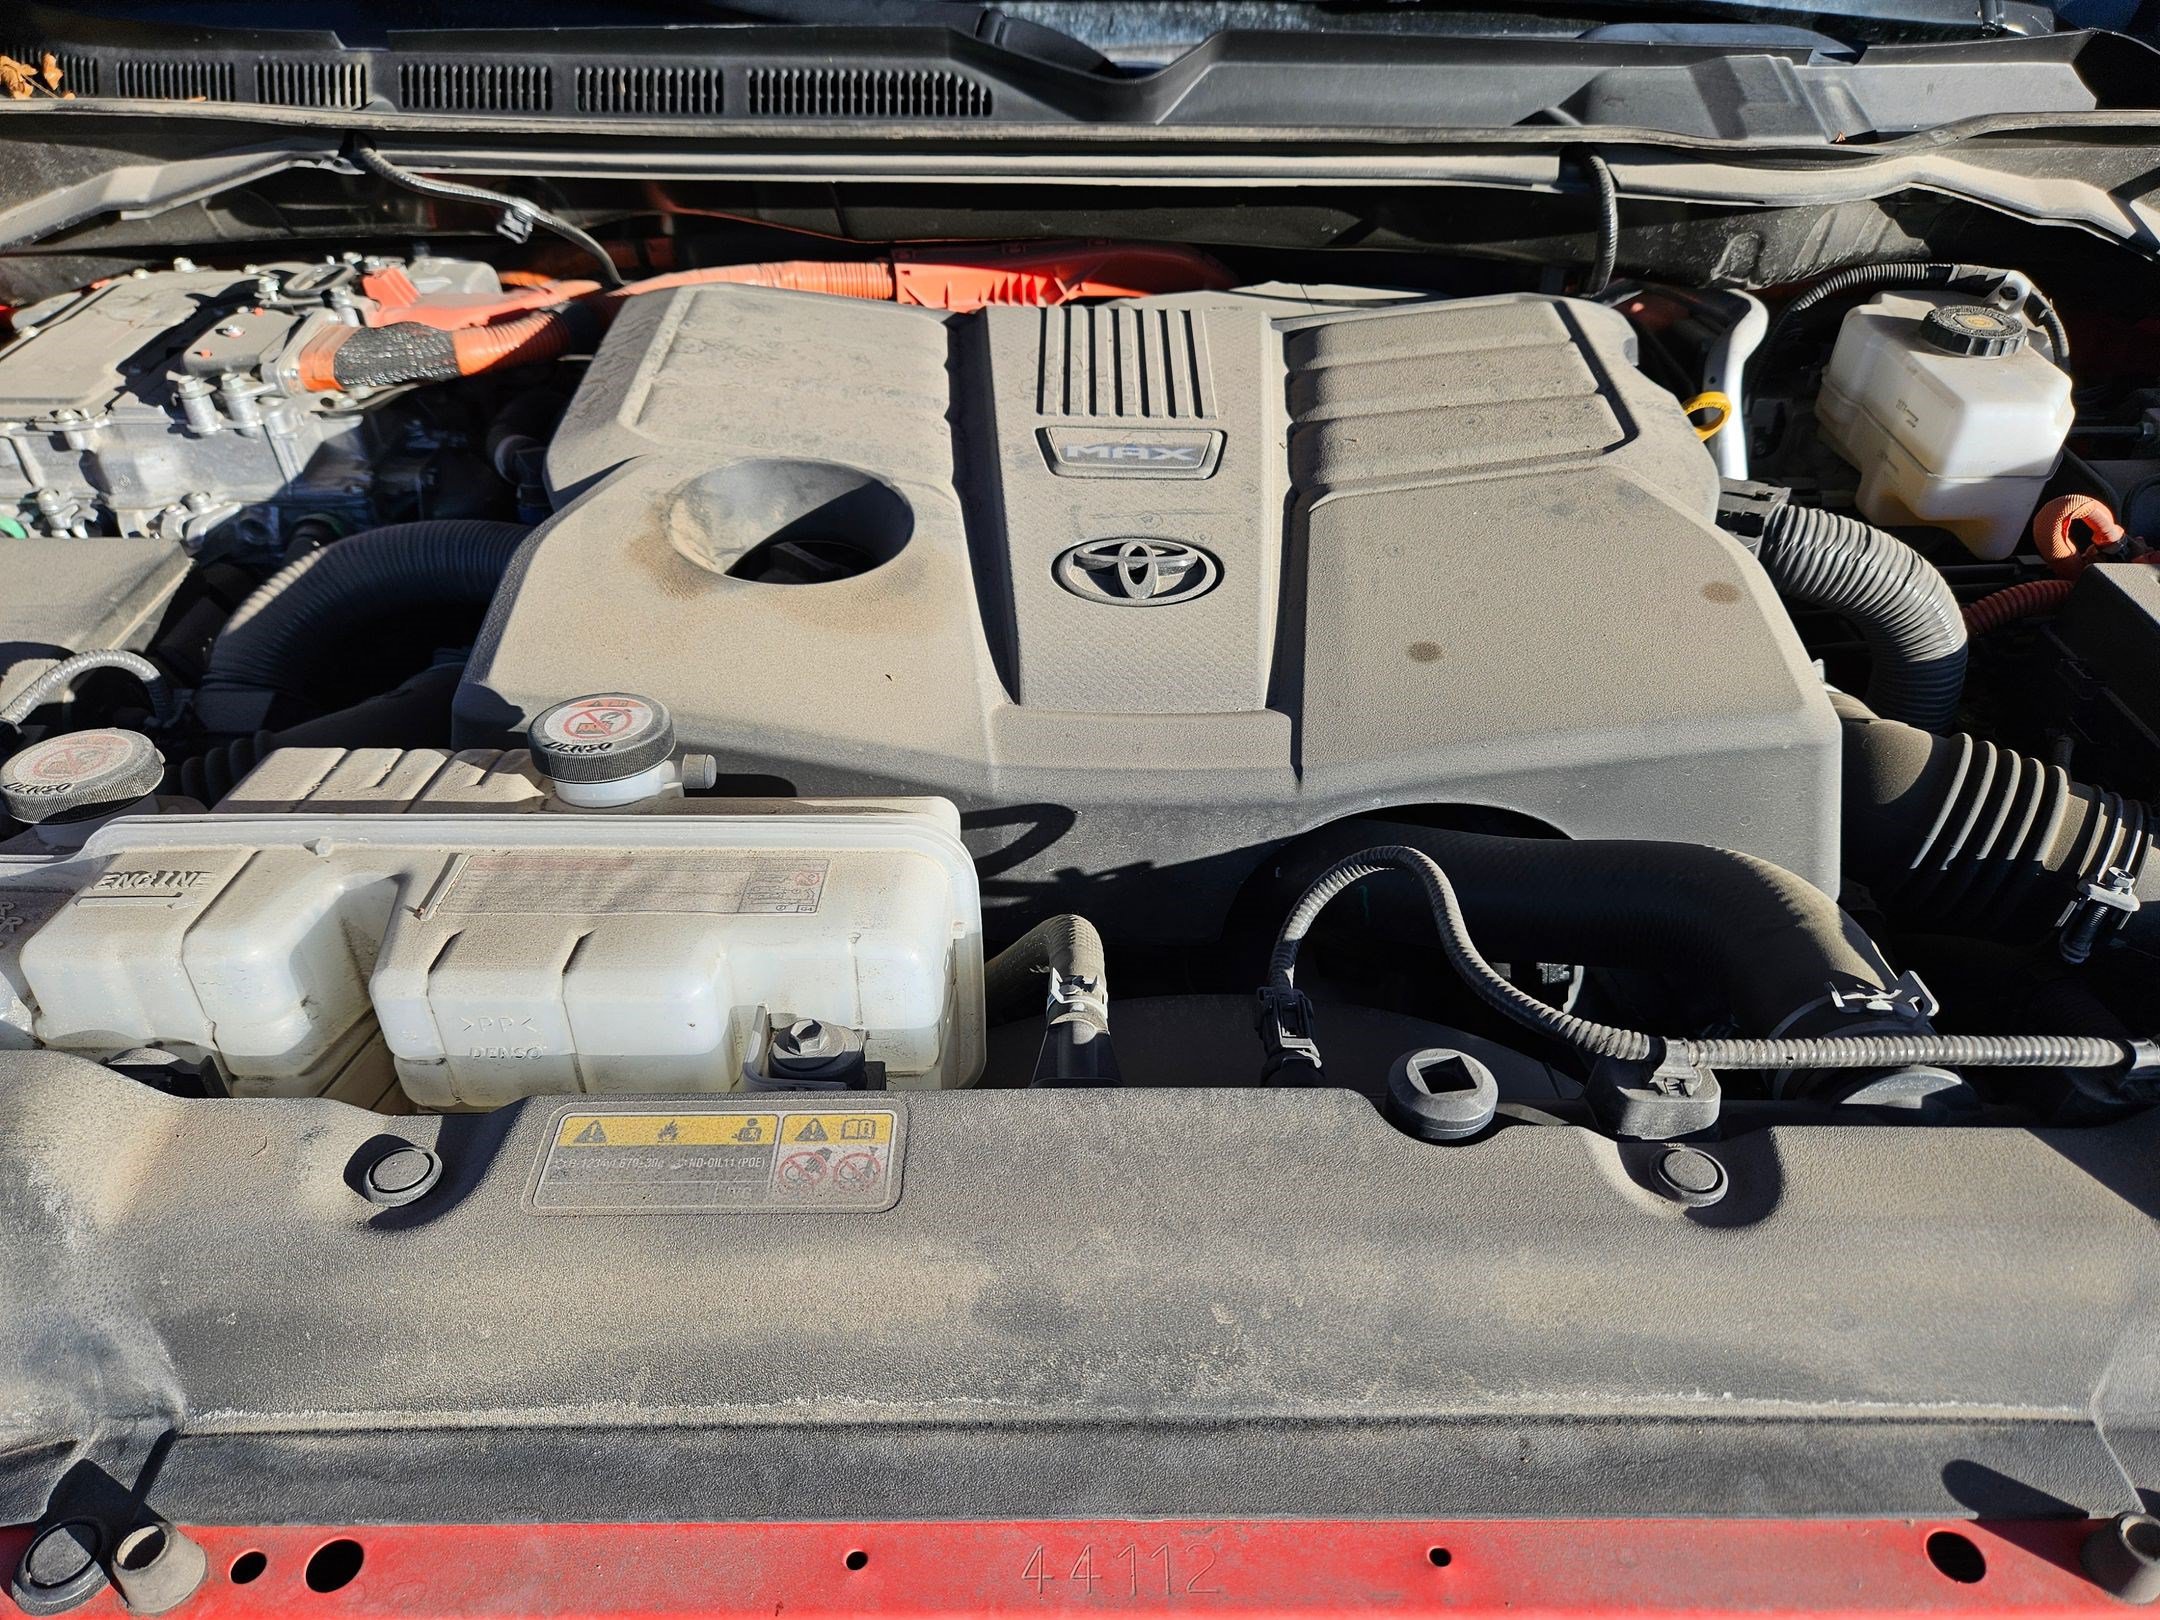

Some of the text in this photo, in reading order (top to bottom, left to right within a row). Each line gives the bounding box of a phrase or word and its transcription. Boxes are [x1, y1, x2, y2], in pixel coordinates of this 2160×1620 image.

[1065, 442, 1196, 461] MAX
[541, 740, 614, 754] DENSO
[3, 781, 73, 795] DENSO
[92, 869, 213, 890] ENGINE
[468, 1045, 544, 1060] DENSO
[737, 1156, 766, 1170] (POE)
[1020, 1542, 1222, 1596] 44112
